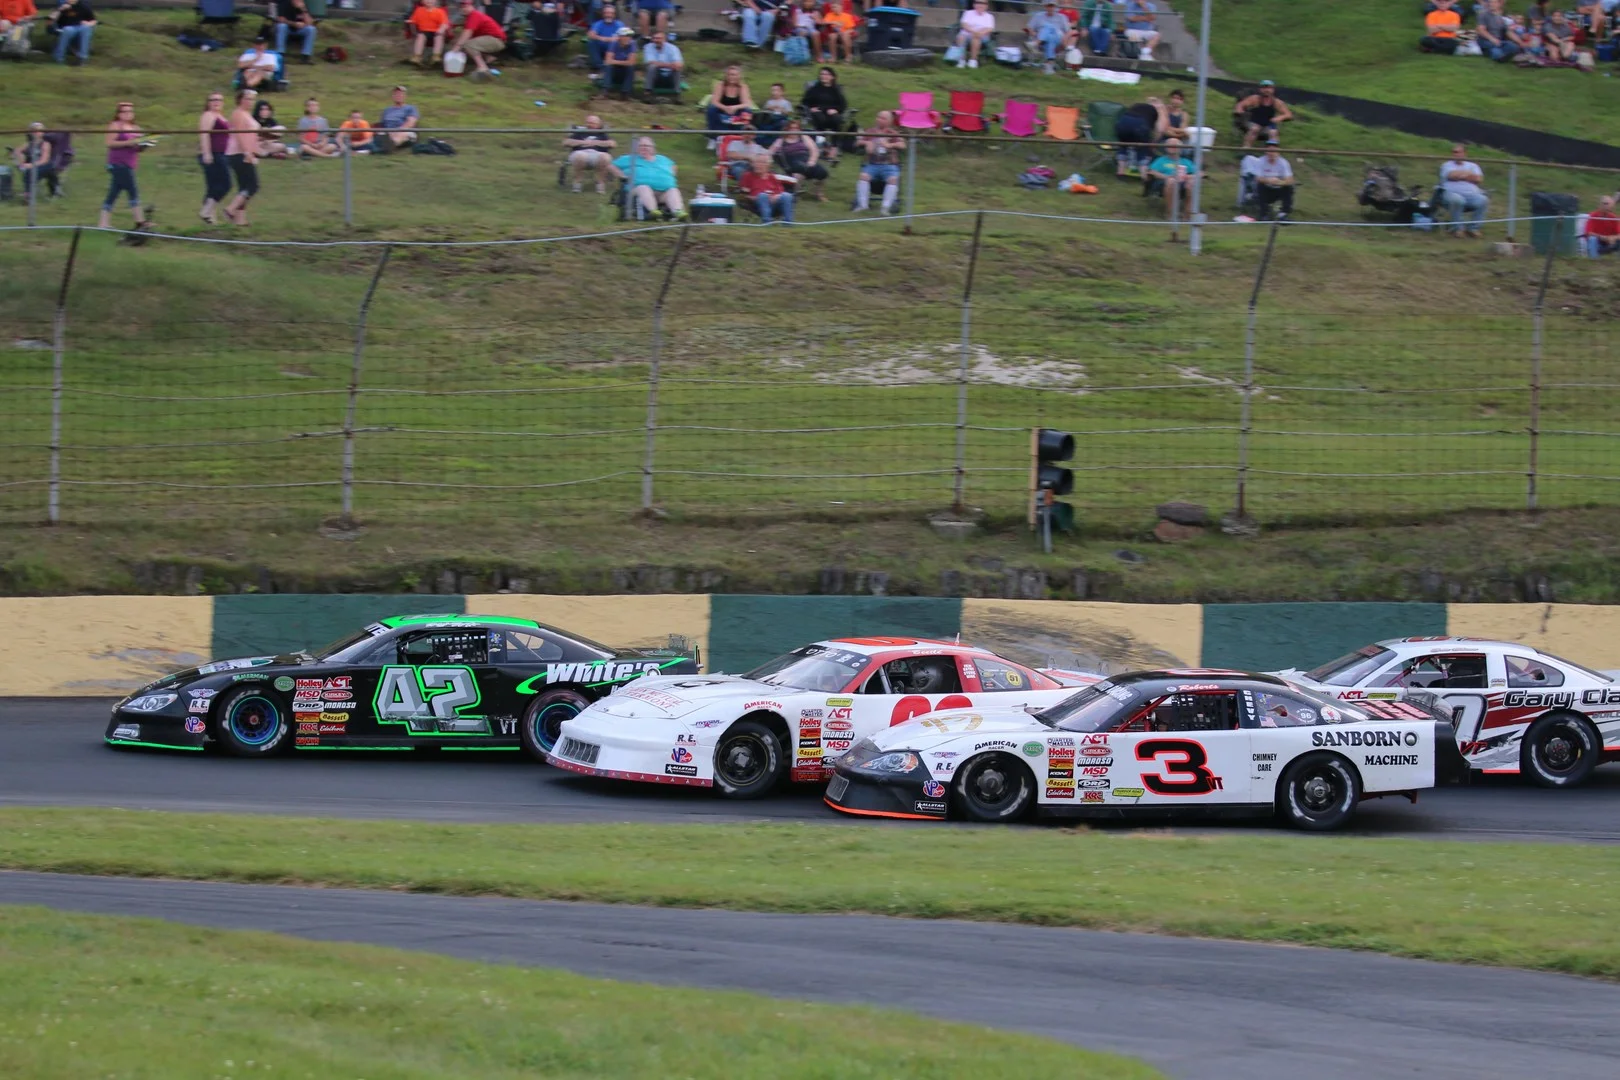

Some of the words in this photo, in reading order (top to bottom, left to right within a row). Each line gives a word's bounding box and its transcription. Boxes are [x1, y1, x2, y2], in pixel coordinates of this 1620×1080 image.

[547, 661, 660, 684] White's
[297, 680, 322, 688] Holley
[323, 677, 352, 688] ACT
[1338, 691, 1363, 699] ACT
[1503, 690, 1575, 710] Gary
[1581, 688, 1620, 705] Cla
[372, 665, 493, 736] 42
[744, 701, 782, 710] AMERICAN
[828, 708, 853, 718] ACT
[500, 718, 517, 734] VT
[800, 718, 821, 727] Holley
[1081, 734, 1110, 744] ACT
[1312, 731, 1401, 746] SANBORN
[975, 740, 1018, 750] AMERICAN
[1048, 748, 1075, 757] Holley
[1252, 753, 1277, 761] CHIMNEY
[1364, 755, 1418, 765] MACHINE
[1134, 738, 1215, 796] 3
[1205, 777, 1224, 790] VT
